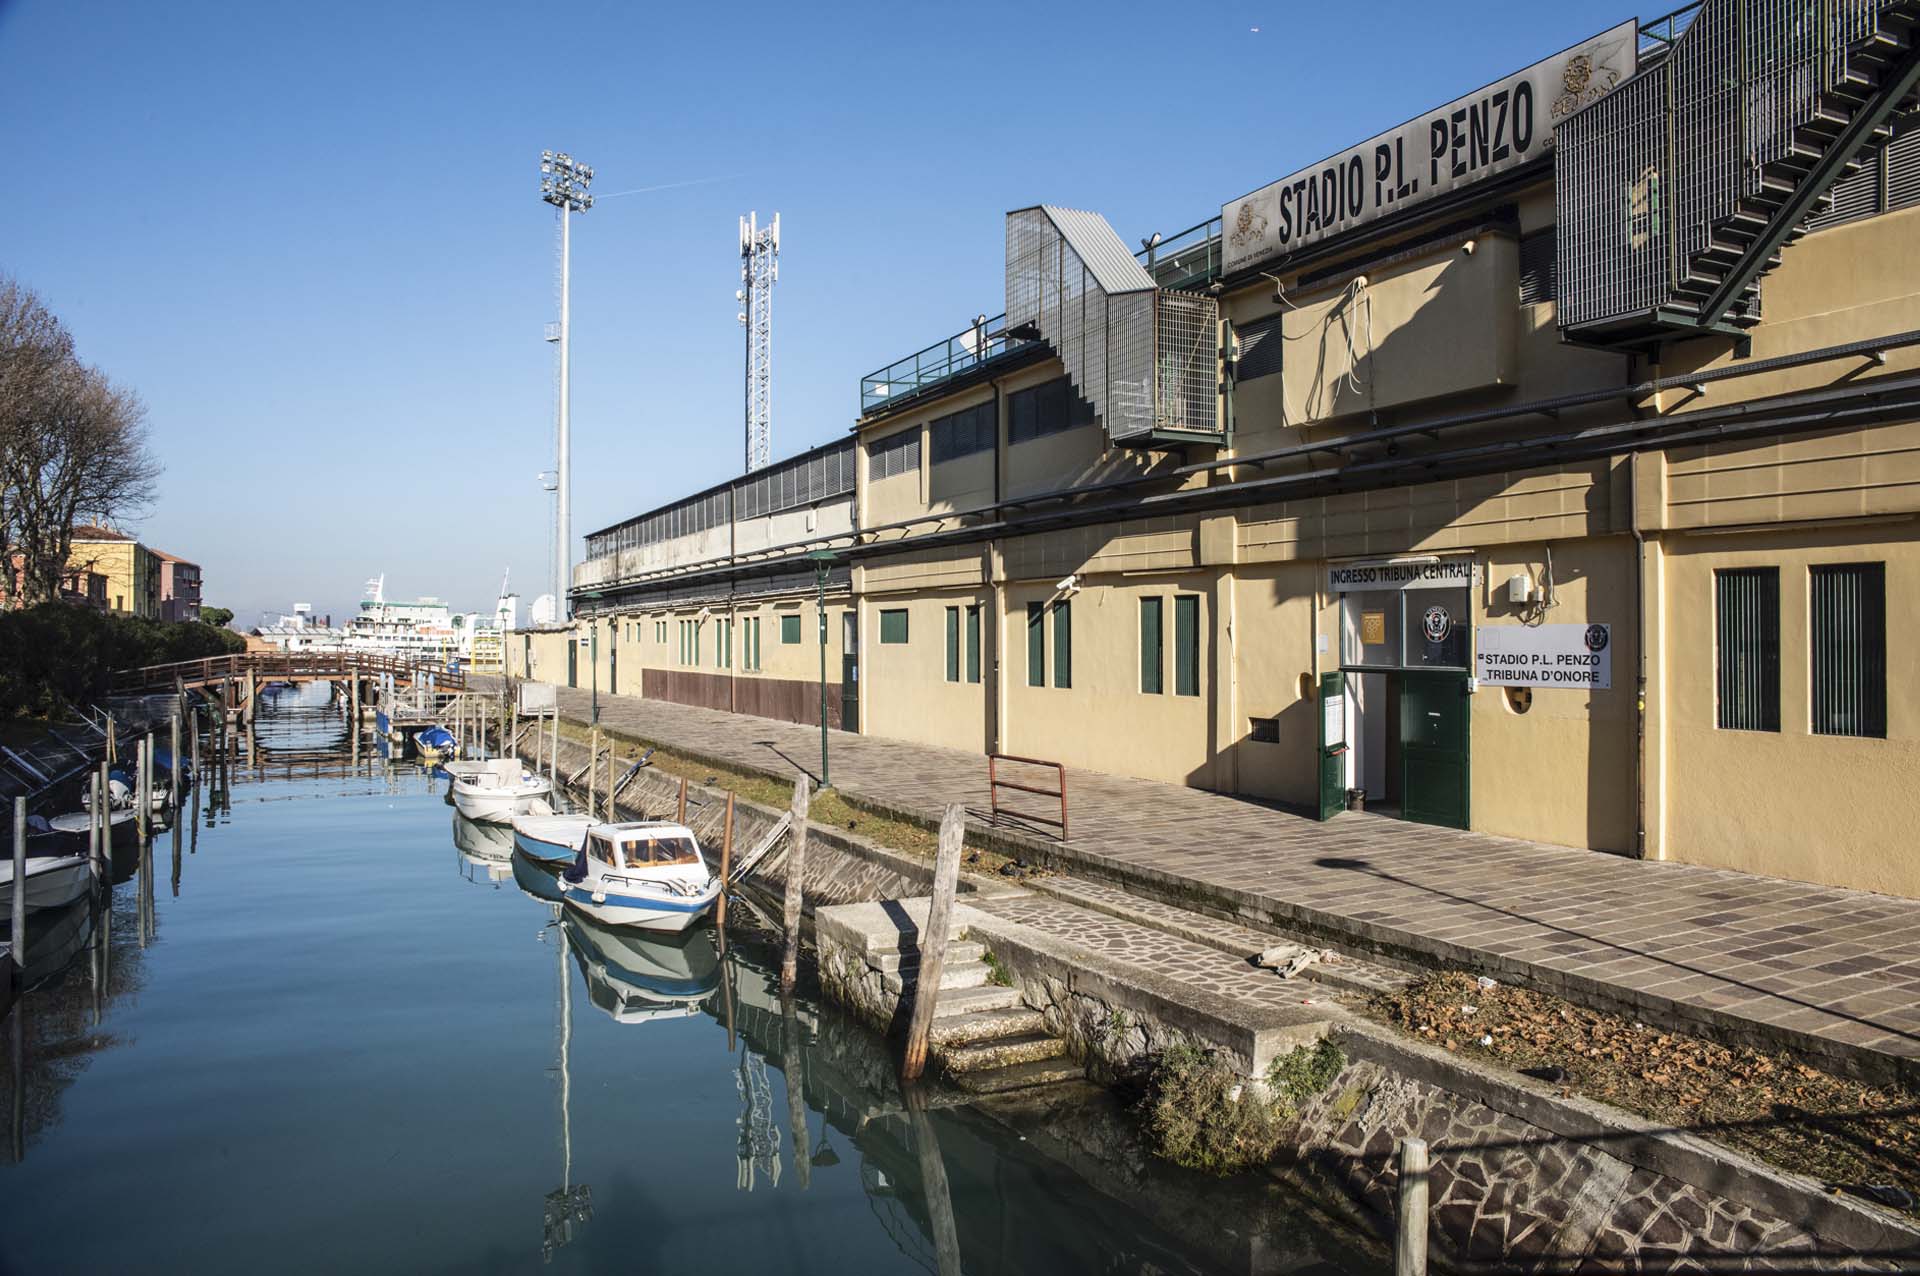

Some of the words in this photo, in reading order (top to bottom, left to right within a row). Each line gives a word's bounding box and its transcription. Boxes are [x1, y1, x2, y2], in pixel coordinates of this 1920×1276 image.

[1279, 154, 1364, 245] STADIO
[1375, 136, 1418, 208] P.L.
[1430, 80, 1533, 186] PENZO
[1227, 255, 1247, 269] COMUNE
[1253, 246, 1273, 258] VENEZIA
[1331, 567, 1376, 585] INGRESSO
[1379, 563, 1421, 582] TRIBUNA
[1423, 560, 1476, 579] CENTRAL
[1485, 653, 1528, 665] STADIO
[1531, 654, 1553, 665] P.L.
[1556, 654, 1601, 666] PENZO
[1486, 669, 1538, 681] TRIBUNA
[1541, 670, 1600, 682] D'ONORE
